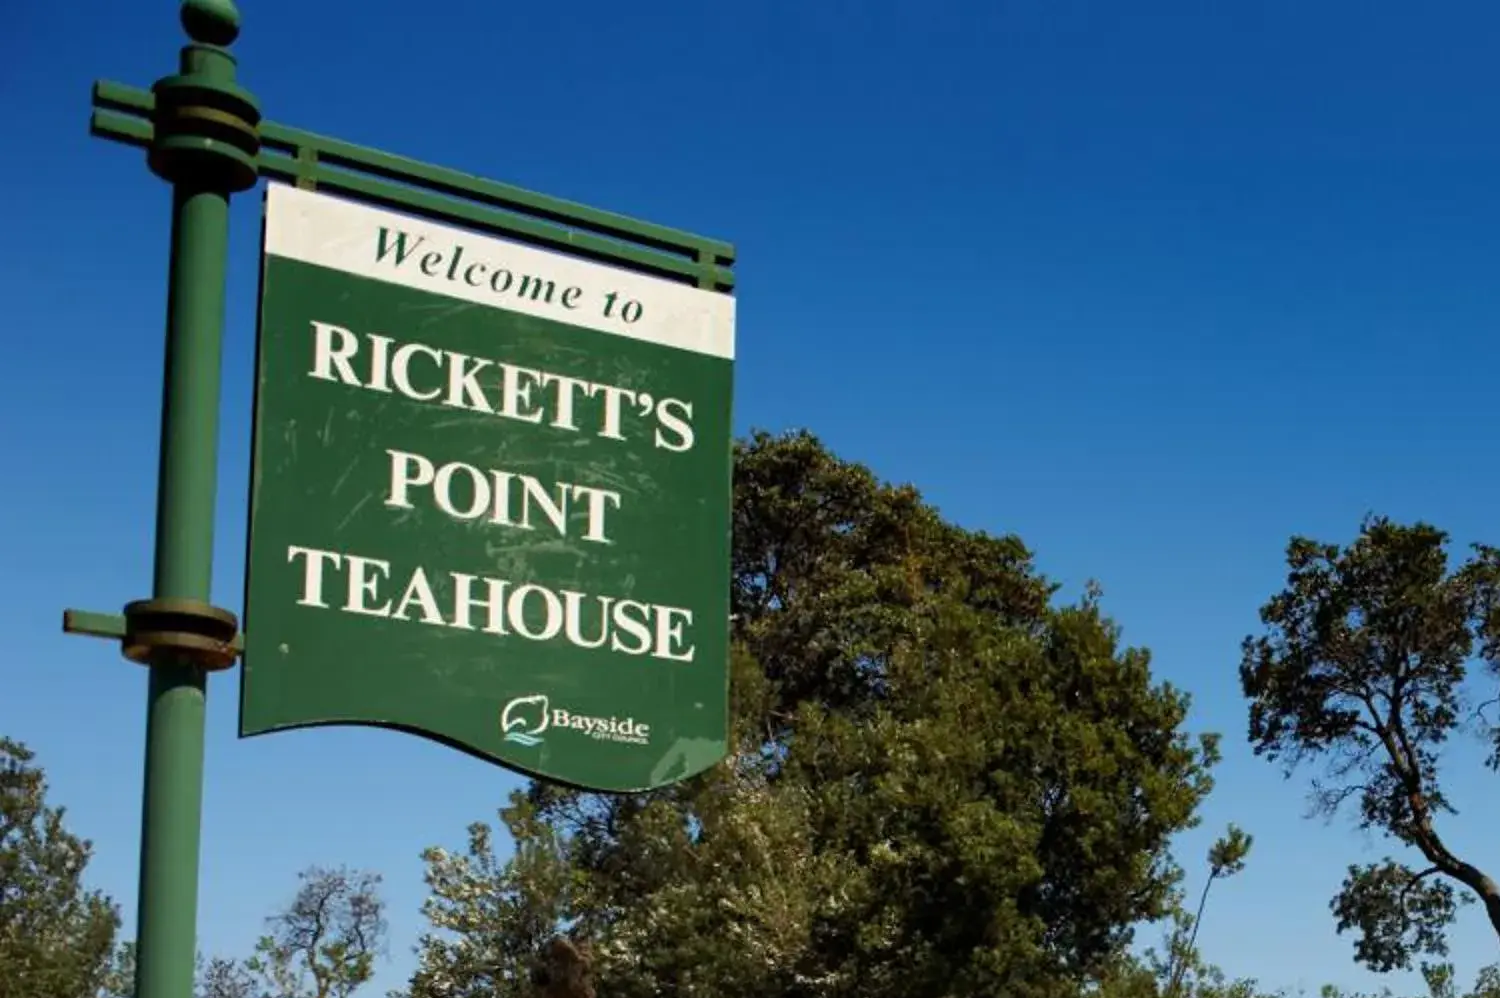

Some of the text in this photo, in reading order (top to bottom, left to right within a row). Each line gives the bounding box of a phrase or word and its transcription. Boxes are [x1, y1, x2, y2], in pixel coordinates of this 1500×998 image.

[376, 226, 645, 325] Welcome to
[307, 319, 696, 452] RICKETT'S
[383, 448, 622, 546] POINT
[287, 544, 696, 663] TEAHOUSE
[552, 708, 650, 737] Bayside
